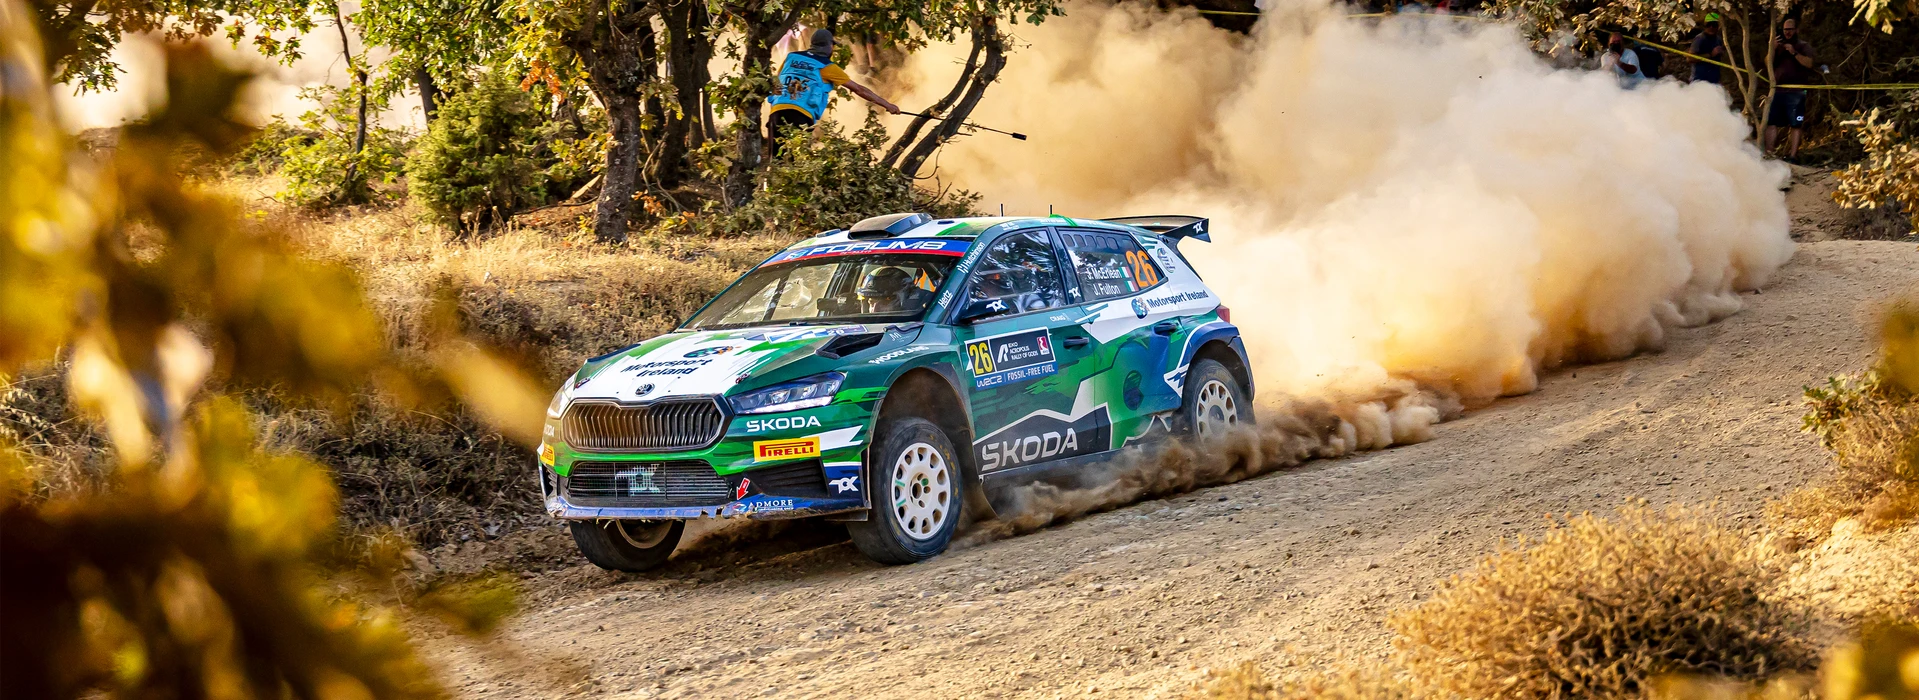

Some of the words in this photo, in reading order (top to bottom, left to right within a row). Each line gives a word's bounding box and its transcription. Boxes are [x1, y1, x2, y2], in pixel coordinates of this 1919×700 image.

[807, 241, 947, 256] FORUM8
[1091, 266, 1122, 279] McErlean
[1125, 250, 1159, 288] 26
[1098, 282, 1121, 295] Fulton
[938, 290, 953, 309] Hertz
[1146, 294, 1186, 308] Motorsport
[1186, 289, 1209, 301] Ireland
[620, 359, 713, 373] Motorsport
[969, 342, 993, 375] 26
[636, 367, 699, 377] Ireland
[977, 375, 1002, 388] WRC2
[1007, 366, 1041, 381] FOSSIL-FREE
[1041, 364, 1055, 374] FUEL
[746, 415, 821, 433] SKODA
[760, 441, 814, 457] PIRELLI
[981, 428, 1078, 471] SKODA
[749, 499, 794, 508] ADMORE
